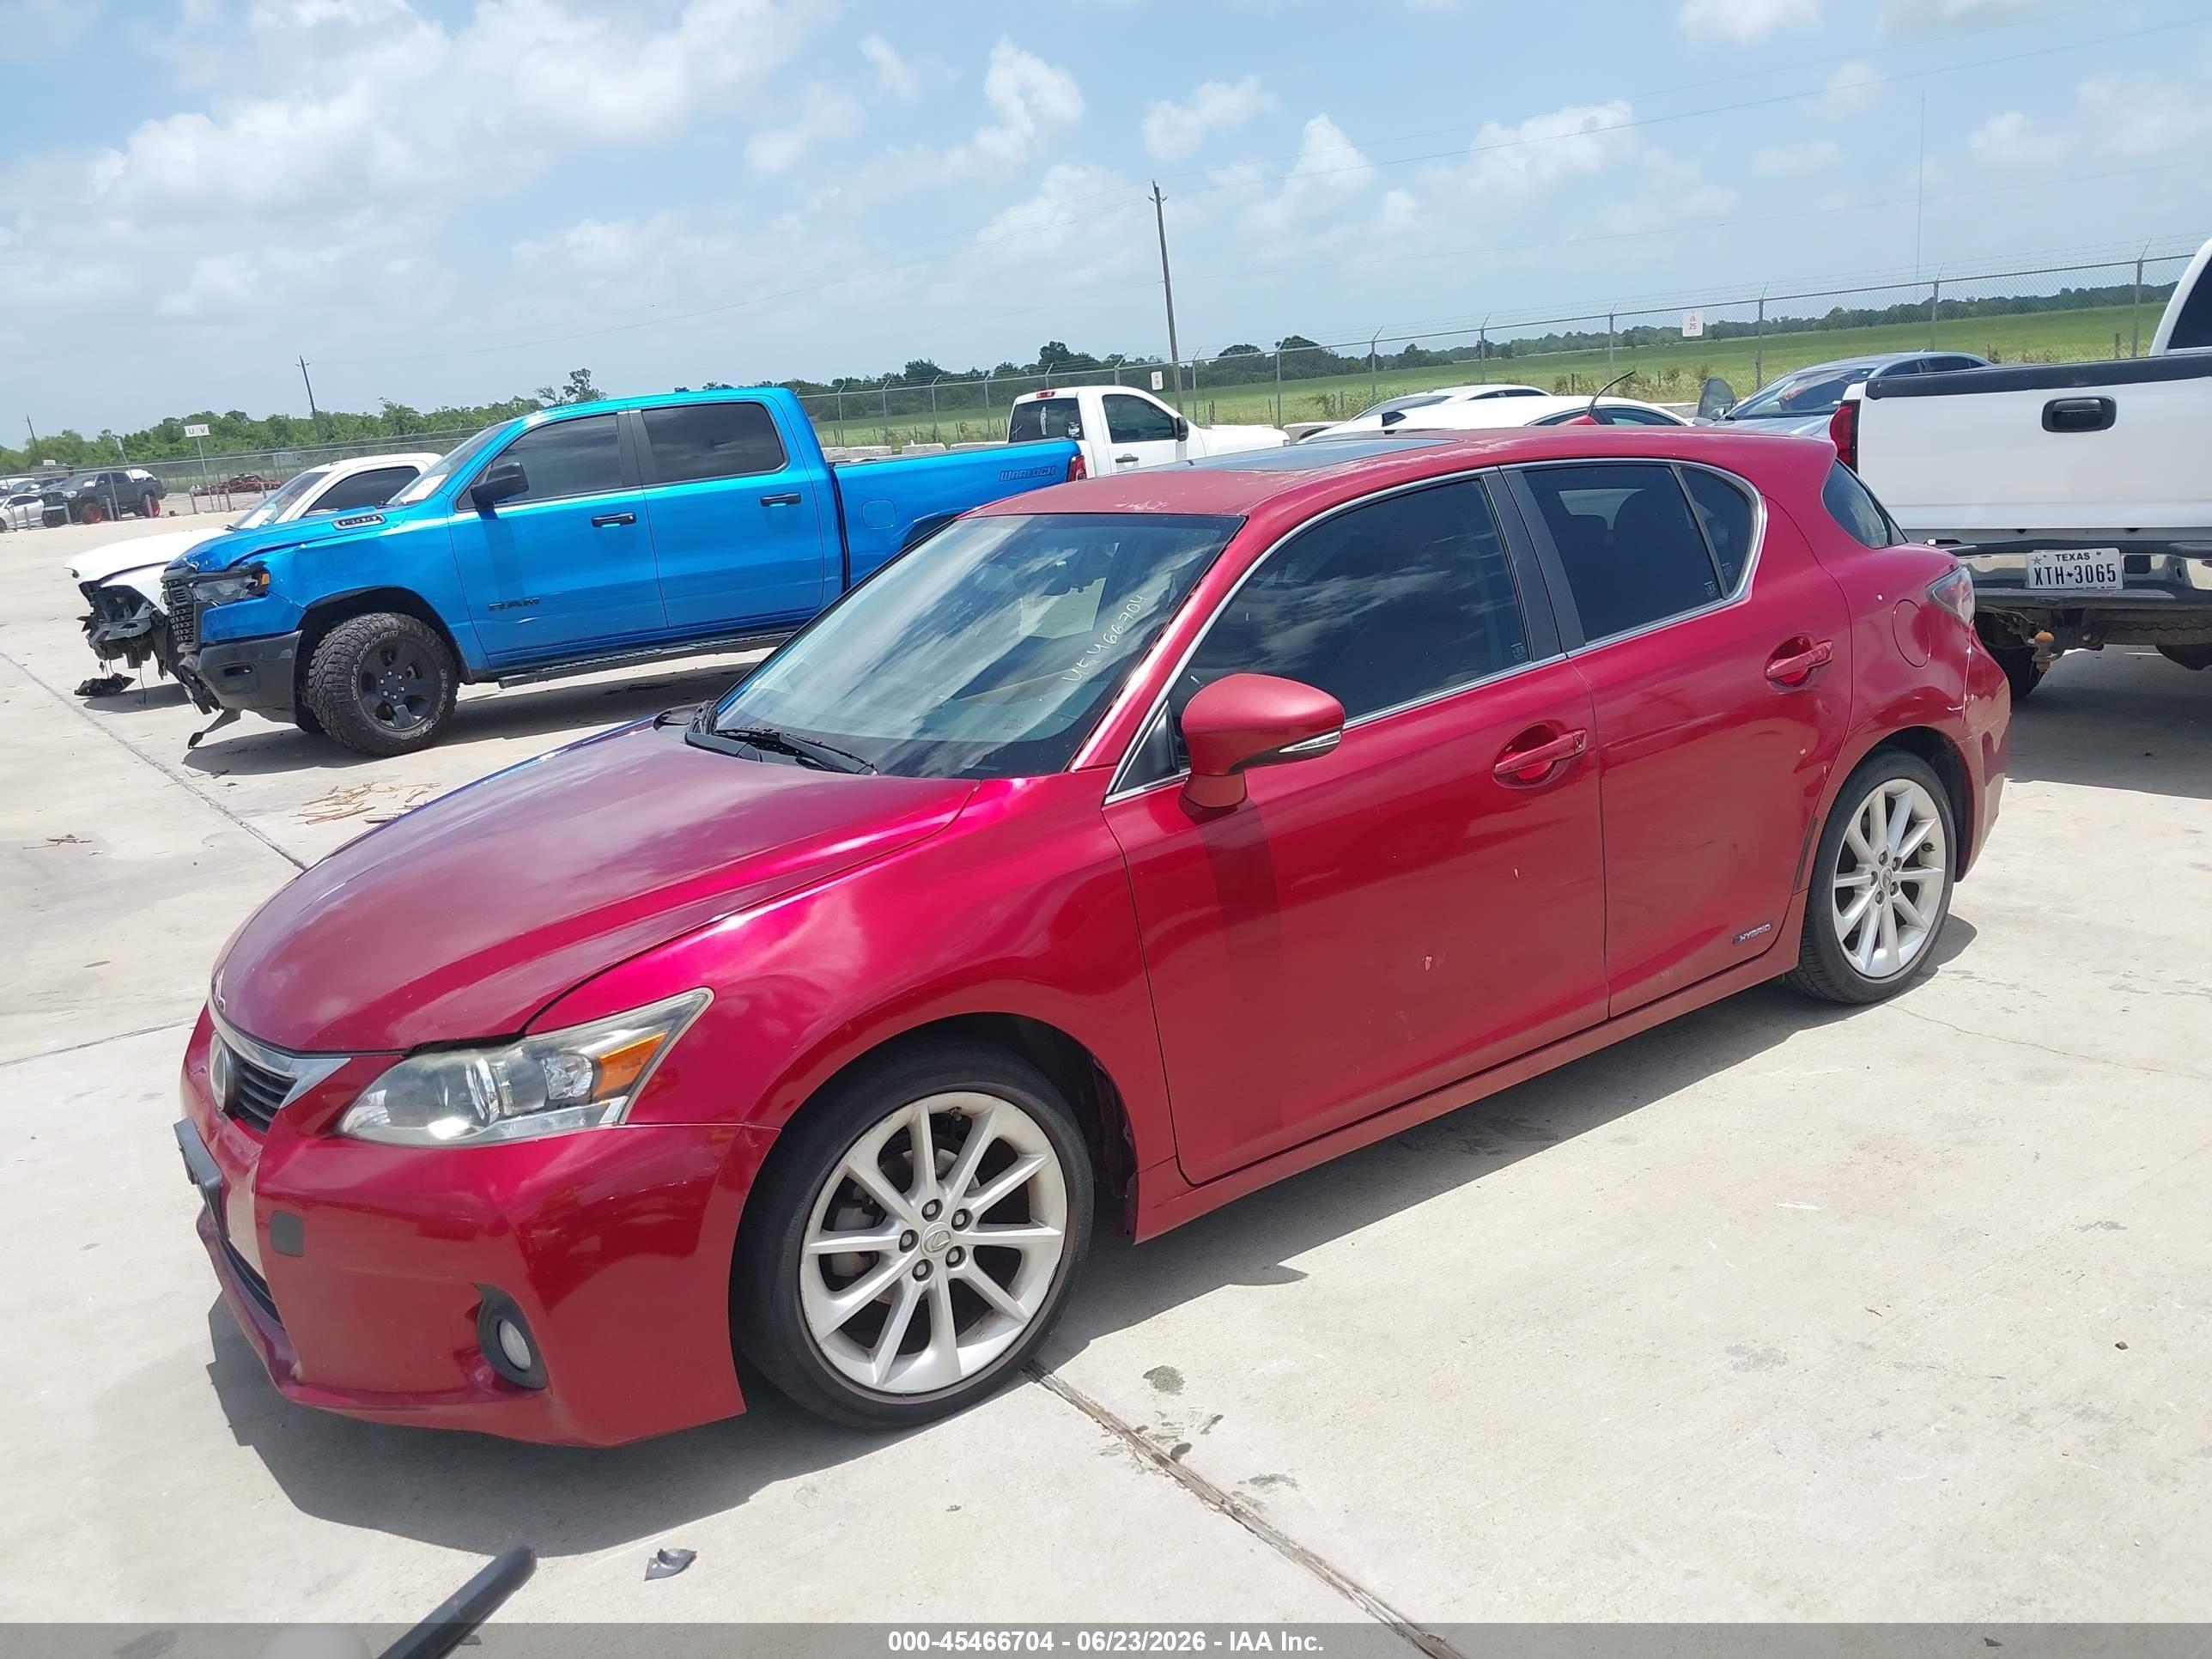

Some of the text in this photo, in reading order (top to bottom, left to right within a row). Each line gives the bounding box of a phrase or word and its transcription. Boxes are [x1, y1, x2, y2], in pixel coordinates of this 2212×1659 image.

[999, 466, 1057, 481] WARLOCK
[2054, 552, 2091, 562] TEXAS
[488, 597, 541, 611] RAM
[1739, 923, 1771, 942] HYBRID
